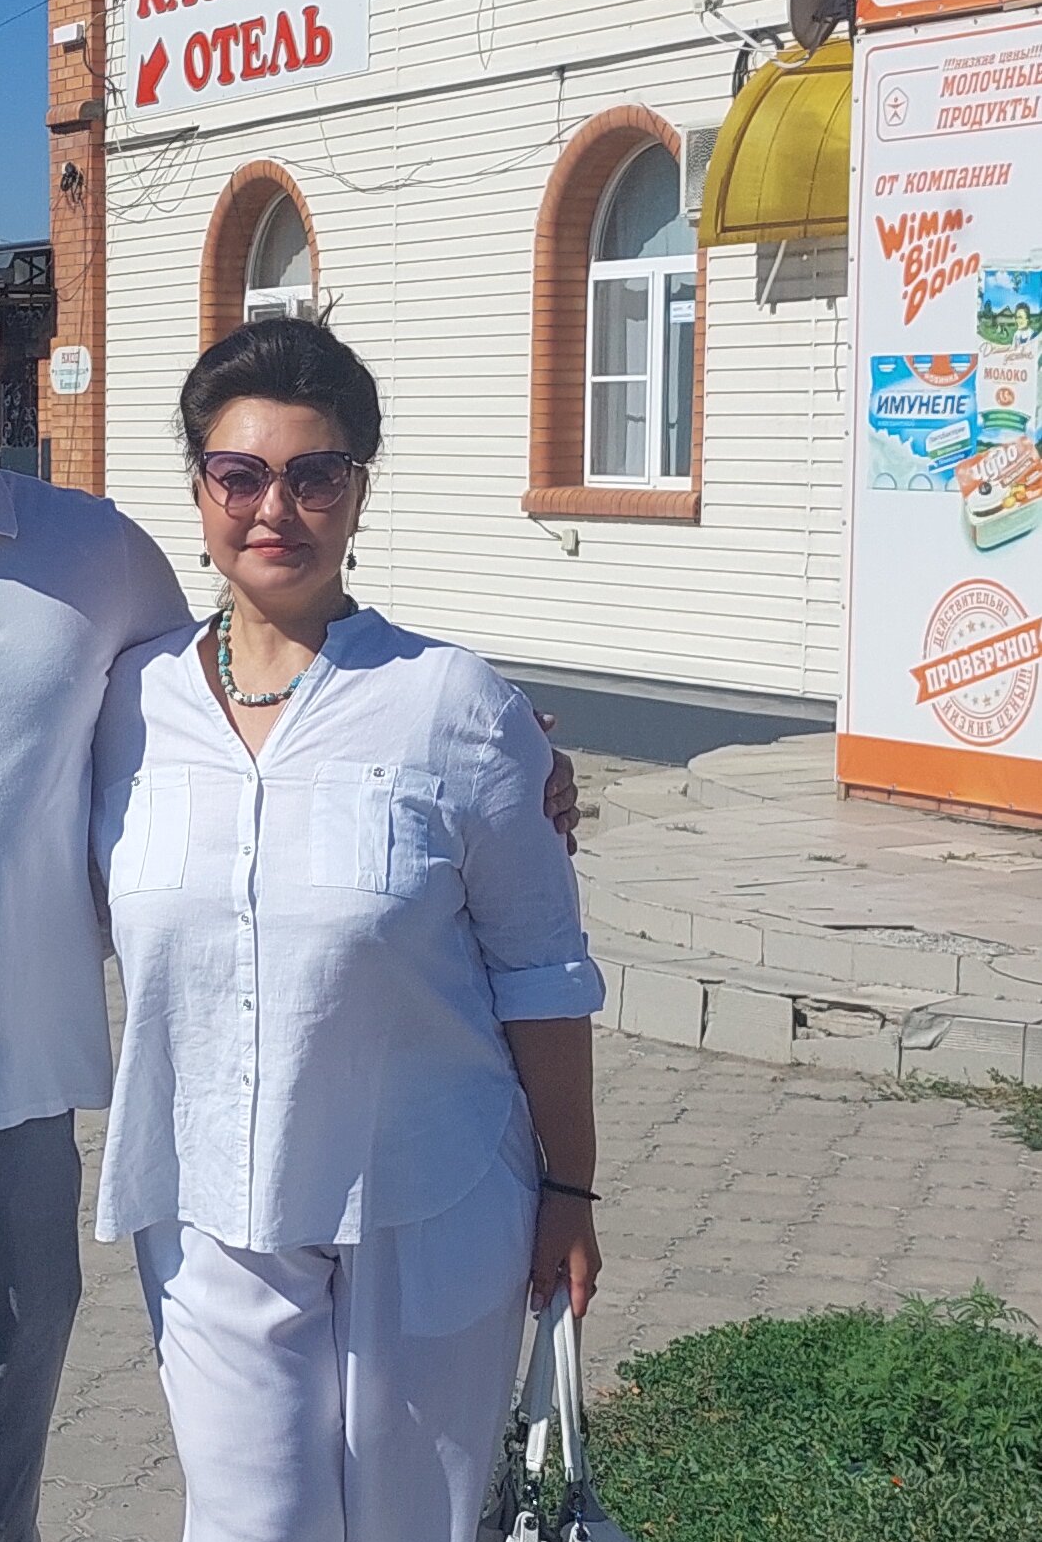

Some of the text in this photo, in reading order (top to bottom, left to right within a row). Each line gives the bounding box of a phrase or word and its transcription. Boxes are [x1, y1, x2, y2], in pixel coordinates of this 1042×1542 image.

[184, 5, 332, 91] ОТЕЛЬ
[940, 63, 1042, 98] МОЛОЧНЫЕ
[936, 95, 1040, 130] ПРОДУКТЫ
[984, 367, 1028, 382] МОЛОКО
[876, 394, 971, 415] ИМУНЕЛЕ
[933, 591, 1010, 649] ДЕЙСТВИТЕЛЬНО
[924, 629, 1039, 694] ПРОВЕРЕНО!
[942, 700, 993, 736] НИЗКИЕ
